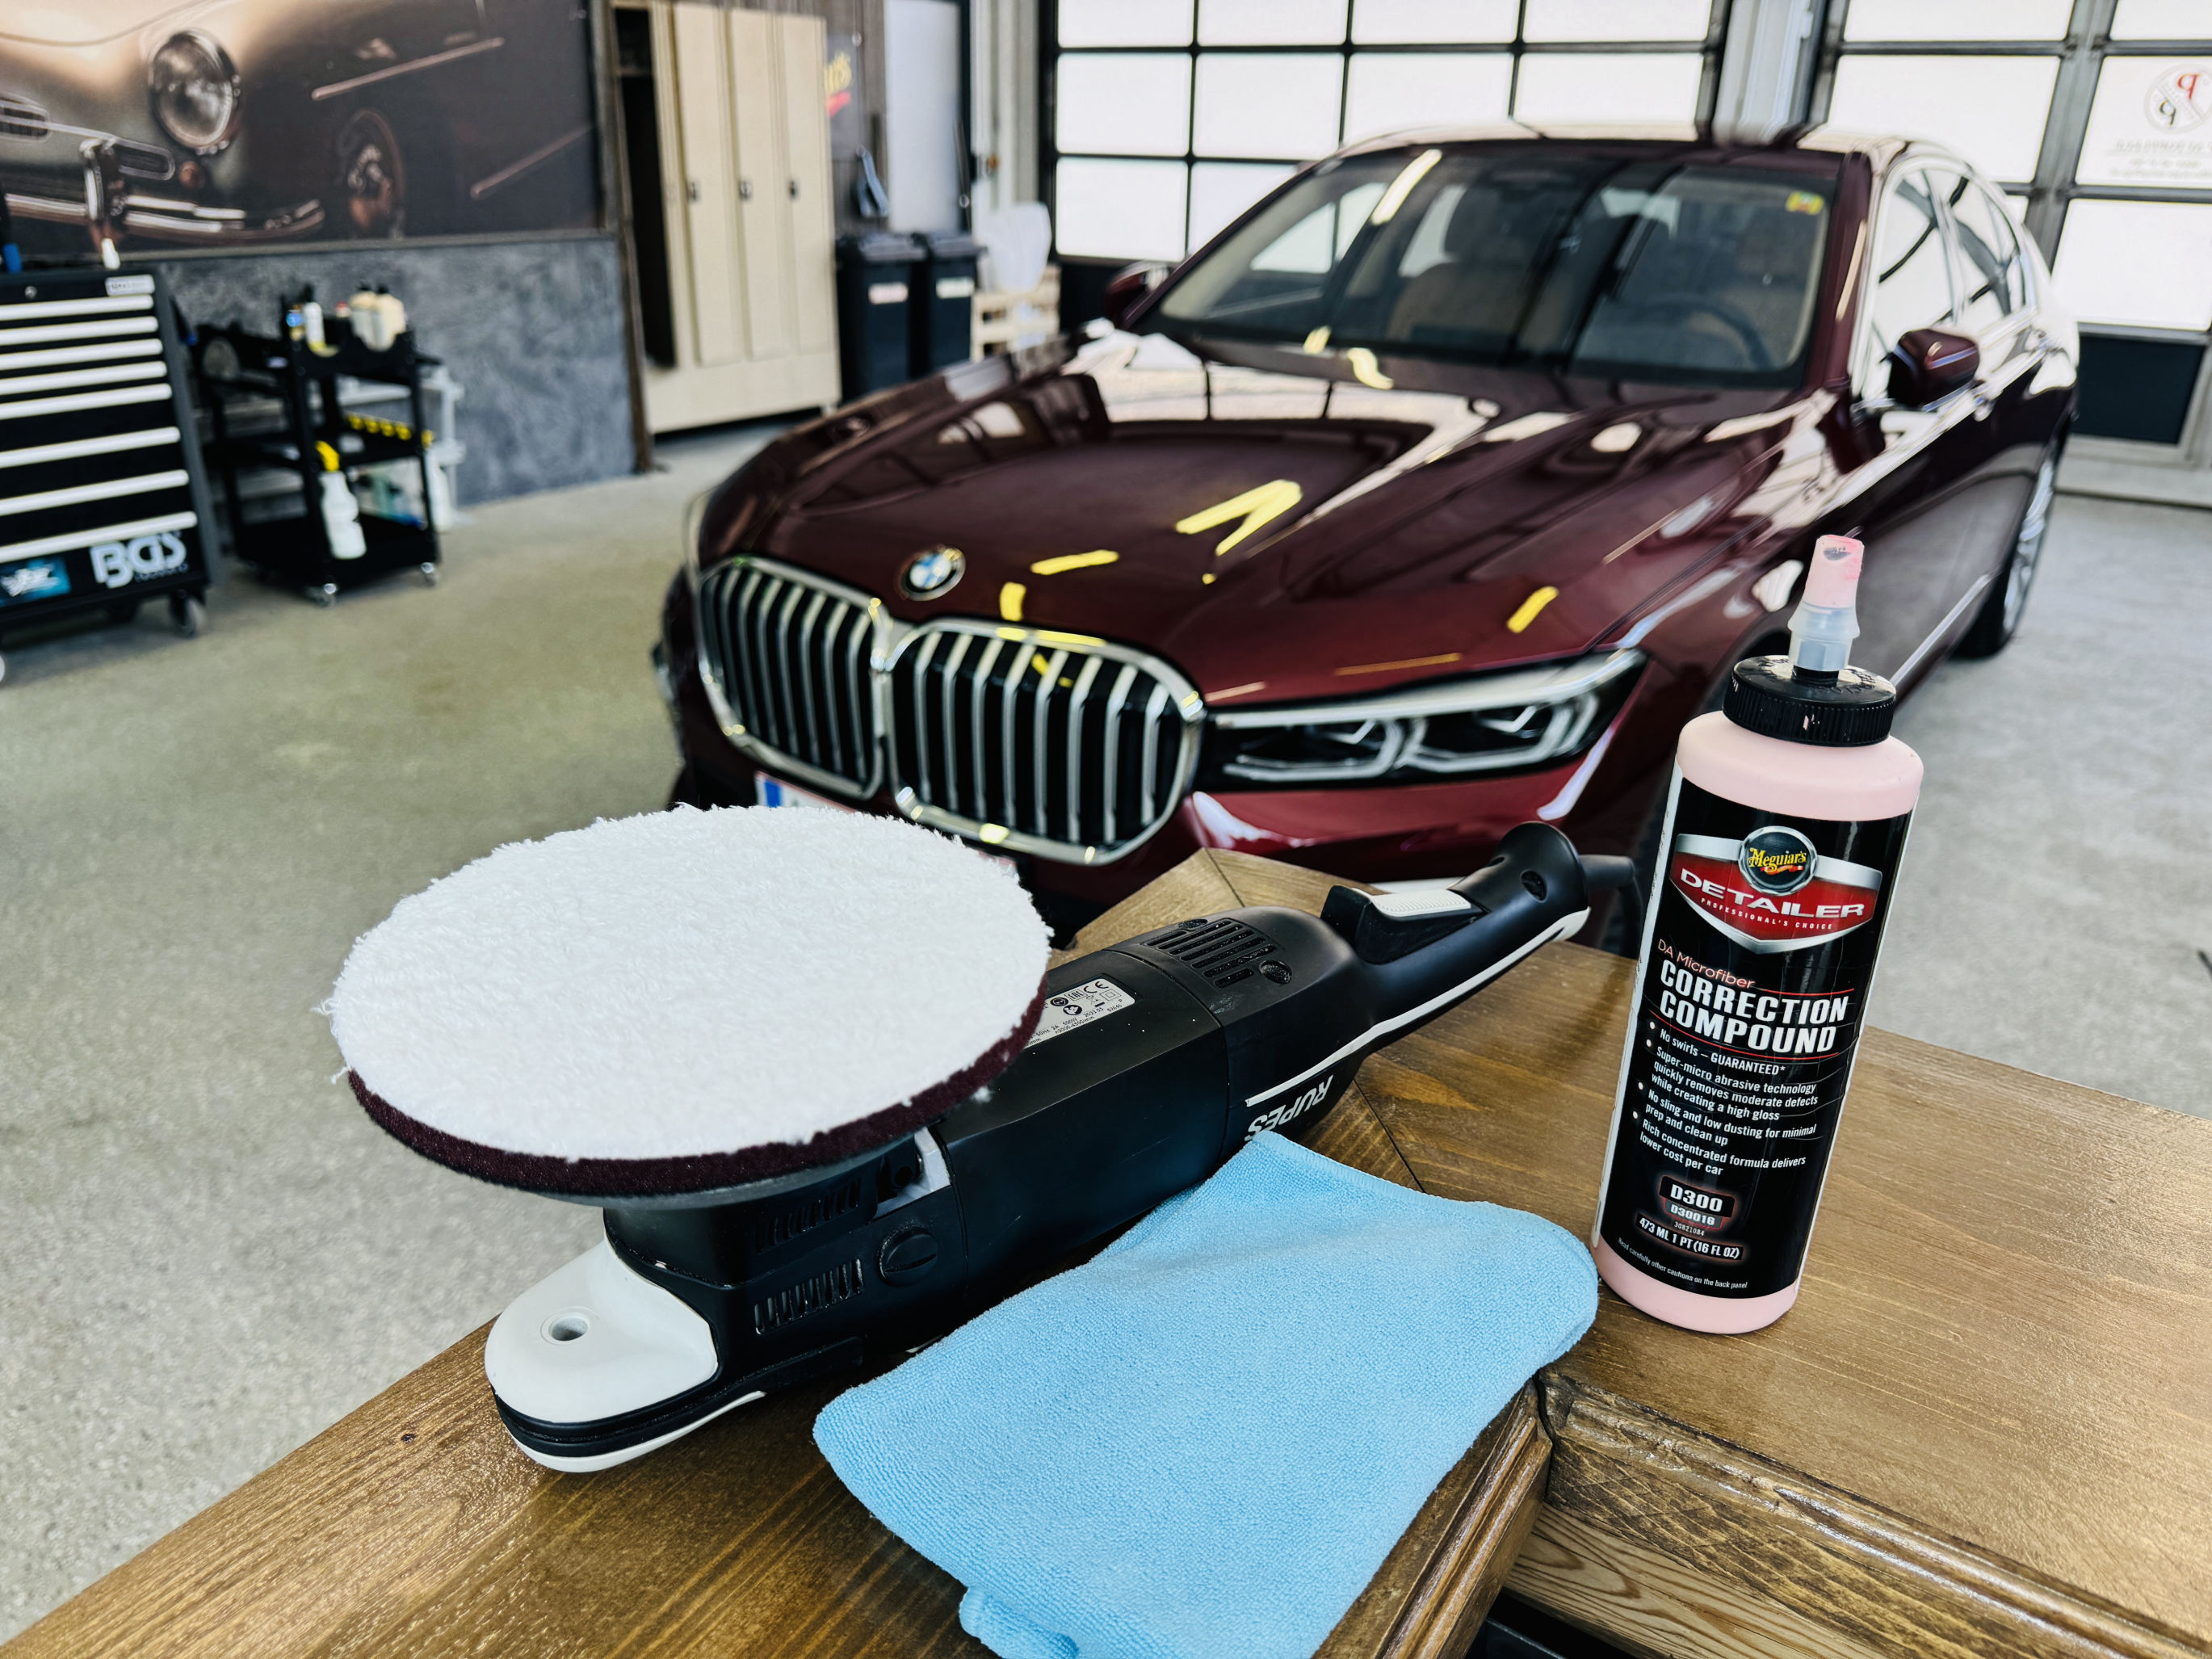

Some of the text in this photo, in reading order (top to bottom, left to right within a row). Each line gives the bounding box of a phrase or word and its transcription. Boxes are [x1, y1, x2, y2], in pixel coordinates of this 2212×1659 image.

[1747, 847, 1807, 873] Meguiar's
[1681, 867, 1865, 918] DETAILER
[1701, 897, 1832, 930] PROFESSIONAL'S CHOICE
[1658, 939, 1756, 989] DA Microfiber
[1660, 959, 1849, 1025] CORRECTION
[1660, 989, 1836, 1053] COMPOUND
[1660, 1028, 1670, 1043] No
[1672, 1038, 1698, 1056] swirls
[1654, 1060, 1819, 1107] quickly removes moderate defects
[1656, 1046, 1817, 1094] Super-micro abrasive technology
[1245, 1074, 1333, 1141] RUPES
[1648, 1089, 1817, 1139] No sling and low dusting for minimal
[1652, 1073, 1780, 1121] while creating a high gloss
[1642, 1119, 1807, 1169] Rich concentrated formula delivers
[1645, 1103, 1728, 1147] prep and clean up
[1639, 1132, 1723, 1175] lower cost per car
[1670, 1184, 1723, 1212] D300
[1670, 1203, 1715, 1225] D30016
[1639, 1217, 1740, 1259] 473 ML 1 PT (16 FL OZ)
[1652, 1261, 1666, 1272] other
[1715, 1280, 1730, 1288] back
[1731, 1282, 1748, 1290] panel
